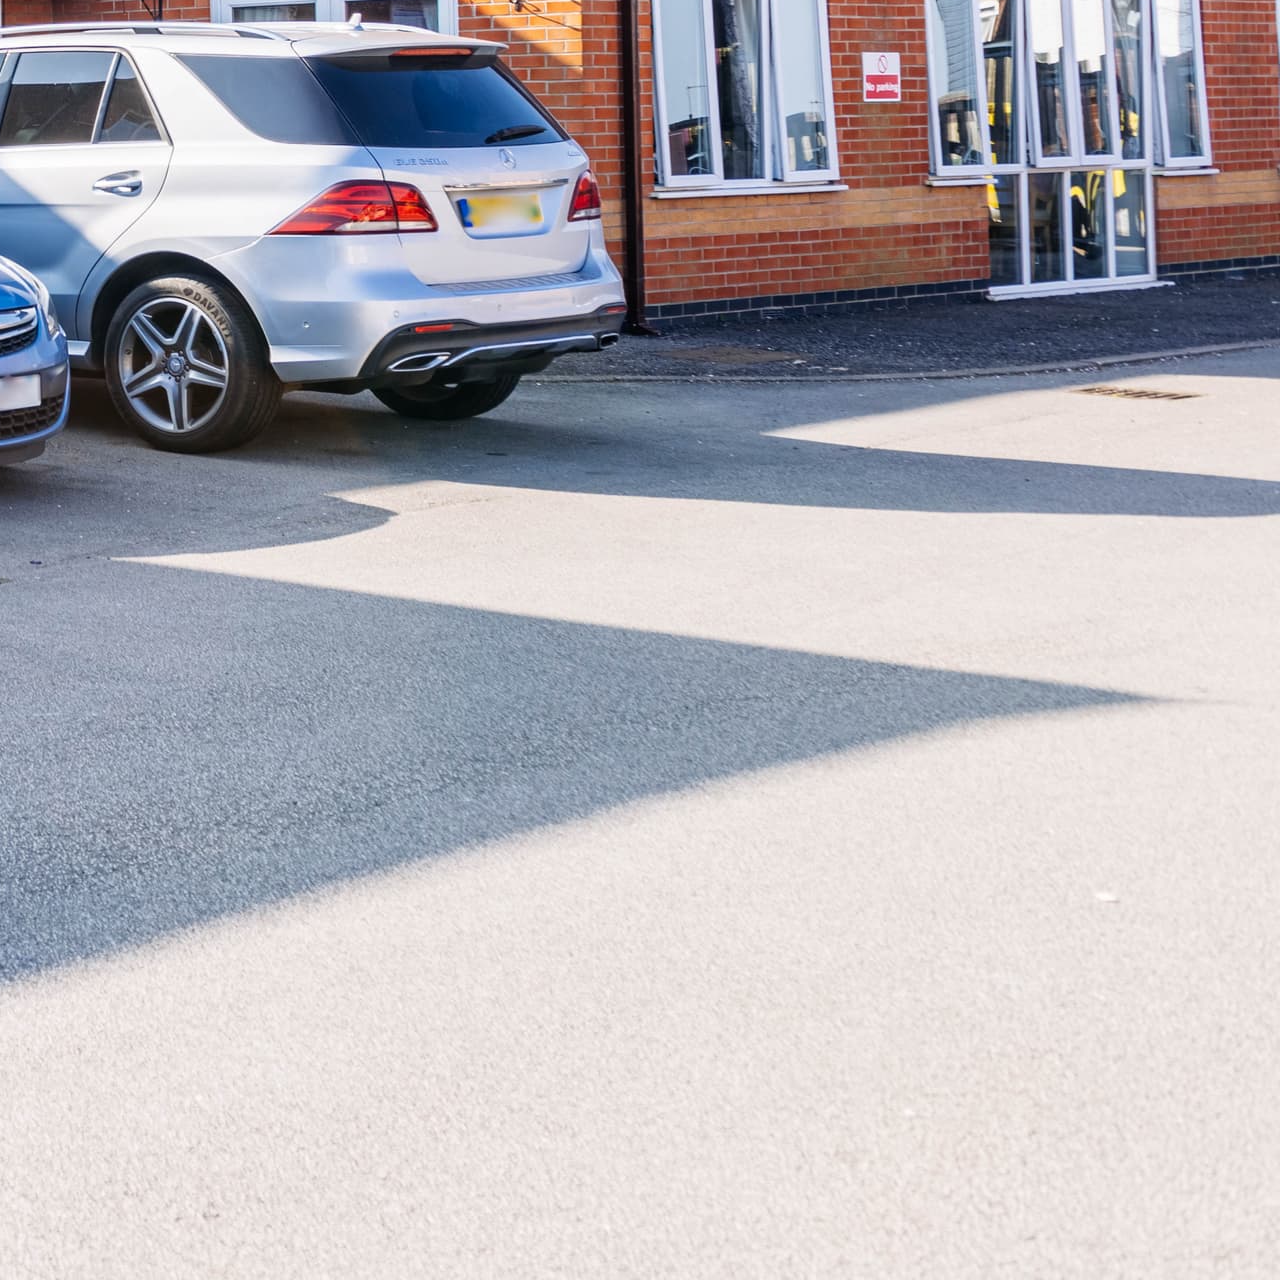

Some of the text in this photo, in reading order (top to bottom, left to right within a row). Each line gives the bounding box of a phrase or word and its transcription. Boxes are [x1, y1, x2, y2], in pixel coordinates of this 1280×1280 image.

[866, 81, 898, 93] No parking
[193, 292, 231, 337] DAVANTI
